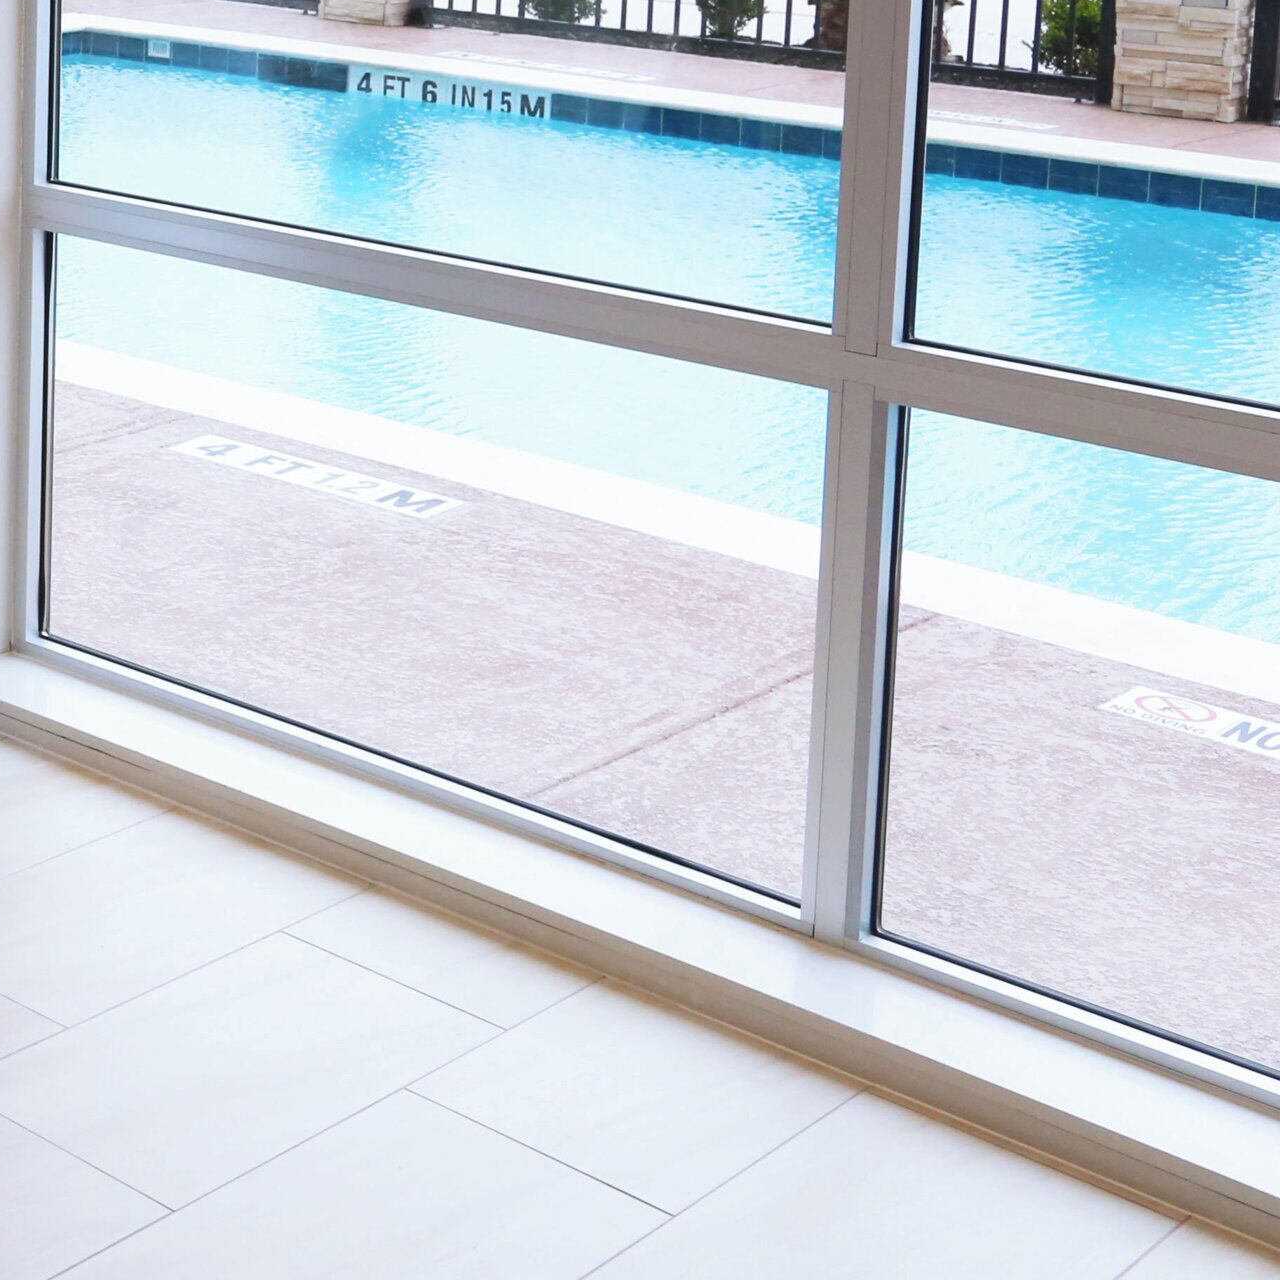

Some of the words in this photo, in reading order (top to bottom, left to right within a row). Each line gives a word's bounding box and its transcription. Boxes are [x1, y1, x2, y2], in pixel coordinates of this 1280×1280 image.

[357, 72, 373, 93] 4
[383, 74, 410, 98] FT
[422, 80, 438, 103] 6
[451, 83, 476, 108] IN
[520, 94, 546, 118] M
[197, 443, 241, 457] 4
[243, 454, 316, 475] FT
[376, 489, 446, 514] M
[1108, 703, 1136, 715] NO
[1140, 713, 1208, 735] DIVING
